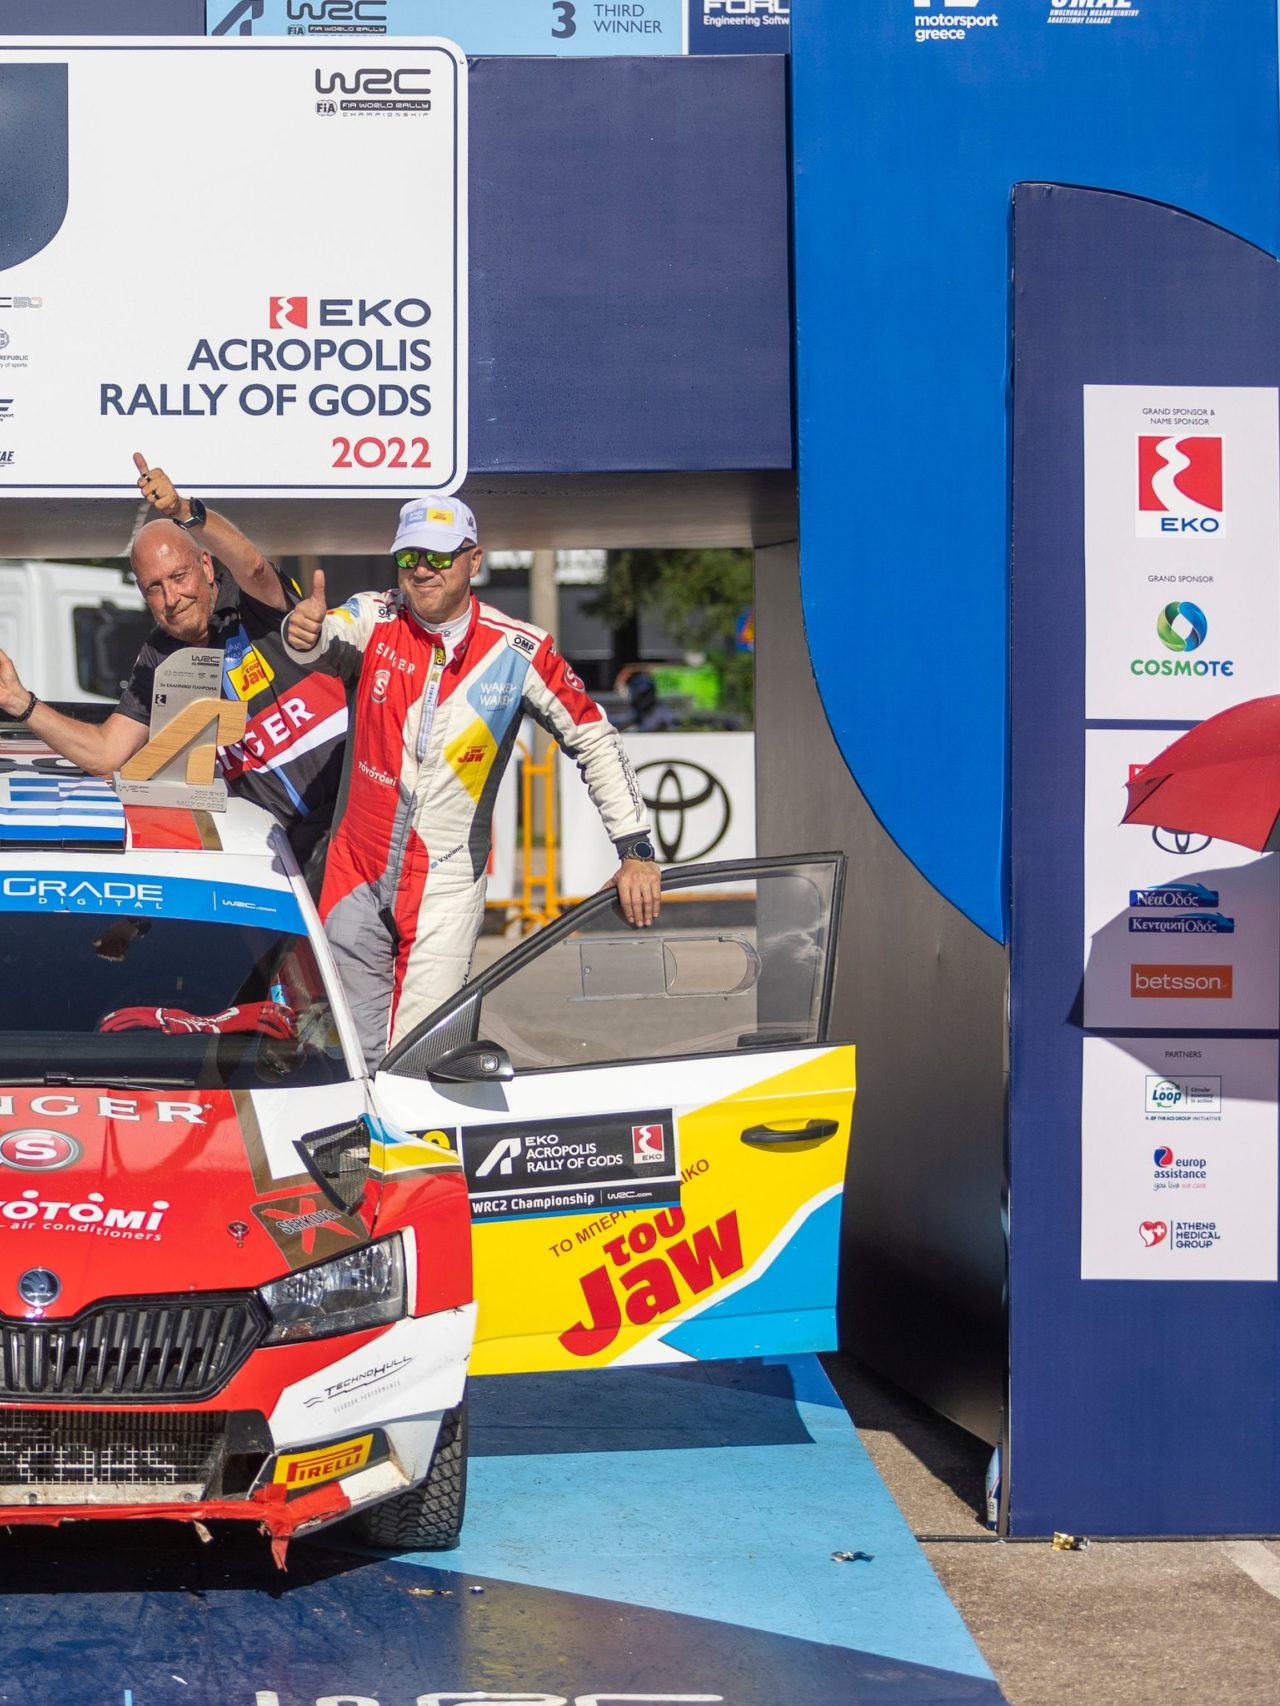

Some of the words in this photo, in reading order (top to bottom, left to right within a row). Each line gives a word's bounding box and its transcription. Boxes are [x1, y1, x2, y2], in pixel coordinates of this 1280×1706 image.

[287, 0, 387, 21] WRC
[594, 4, 645, 17] THIRD
[551, 1, 577, 39] 3
[594, 20, 663, 34] WINNER
[703, 15, 760, 27] Engineering
[914, 14, 999, 28] motorsport
[914, 28, 966, 42] greece
[315, 68, 432, 95] WRC
[358, 102, 393, 110] WORLD
[395, 102, 429, 110] RALLY
[320, 299, 432, 327] EKO
[187, 338, 432, 372] ACROPOLIS
[100, 383, 229, 417] RALLY
[239, 383, 297, 417] OF
[309, 383, 432, 418] GODS
[1142, 408, 1171, 416] GRAND
[1172, 408, 1209, 416] SPONSOR
[1150, 418, 1173, 426] NAME
[1174, 418, 1210, 426] SPONSOR
[332, 437, 432, 469] 2022
[1160, 517, 1220, 533] EKO
[1147, 575, 1177, 583] GRAND
[1178, 575, 1214, 583] SPONSOR
[514, 636, 535, 651] OMP
[1130, 659, 1234, 677] COSMOTE
[480, 682, 517, 695] WAKEY
[479, 693, 514, 707] WAKEY
[457, 749, 486, 764] Jaw
[38, 897, 163, 910] DIGITAL
[1135, 972, 1221, 991] betsson
[1165, 1051, 1203, 1059] PARTNERS
[1152, 1089, 1182, 1105] Loop
[525, 1134, 559, 1147] EKO
[526, 1143, 597, 1160] ACROPOLIS
[641, 1153, 663, 1161] EKO
[527, 1158, 567, 1173] RALLY
[567, 1157, 585, 1169] OF
[587, 1153, 623, 1168] GODS
[1176, 1158, 1207, 1169] europ
[1154, 1168, 1207, 1179] assistance
[472, 1200, 508, 1214] WRC2
[511, 1192, 595, 1211] Championship
[10, 1218, 39, 1231] air
[42, 1221, 162, 1242] conditioners
[1176, 1222, 1216, 1231] ATHENS
[1176, 1231, 1221, 1240] MEDICAL
[1176, 1240, 1213, 1249] GROUP
[558, 1209, 744, 1357] Jaw
[287, 1443, 363, 1483] PIRELLI
